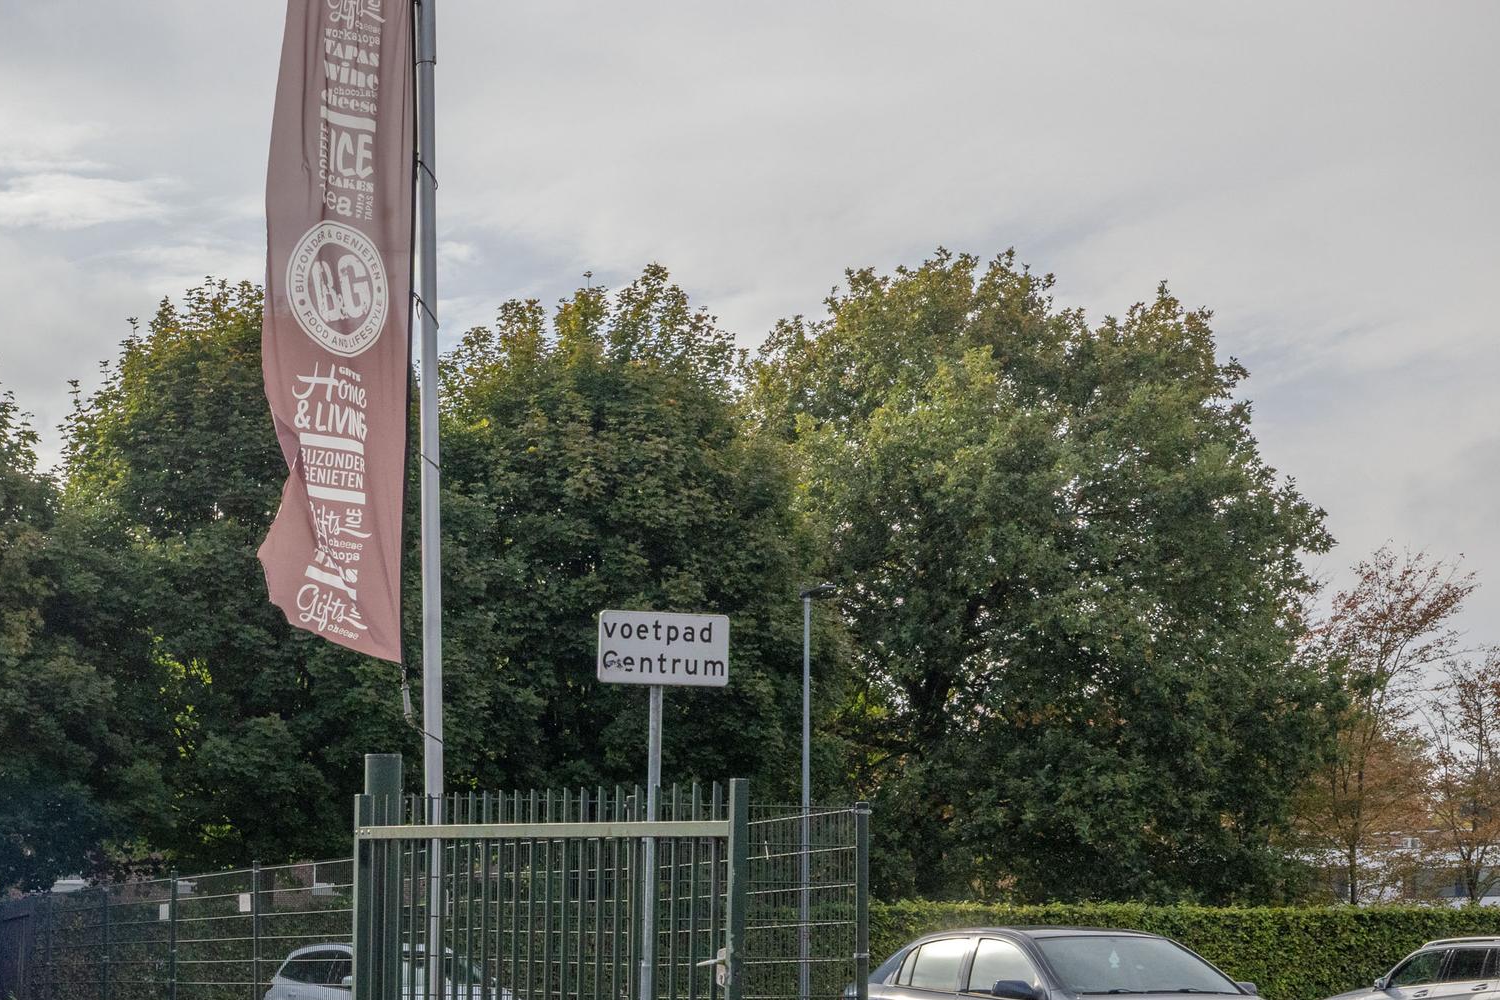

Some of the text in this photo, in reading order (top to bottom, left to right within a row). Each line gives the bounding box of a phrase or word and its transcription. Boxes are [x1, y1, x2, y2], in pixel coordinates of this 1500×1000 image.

[324, 37, 380, 68] TAPAS
[324, 59, 379, 91] wine
[321, 89, 378, 115] cheese
[329, 128, 374, 180] ICE
[328, 174, 374, 193] CAKES
[364, 195, 374, 221] TAPAS
[295, 231, 326, 293] BIJZONDER
[335, 231, 381, 281] GENIETEN
[303, 310, 329, 339] FOOD
[291, 361, 368, 409] Home
[294, 399, 368, 442] & LIVING
[300, 447, 366, 473] BIJZONDER
[345, 508, 362, 528] ICE
[328, 537, 363, 550] cheese
[297, 584, 368, 631] Gifts
[327, 623, 359, 640] cheese
[602, 650, 725, 676] Centrum
